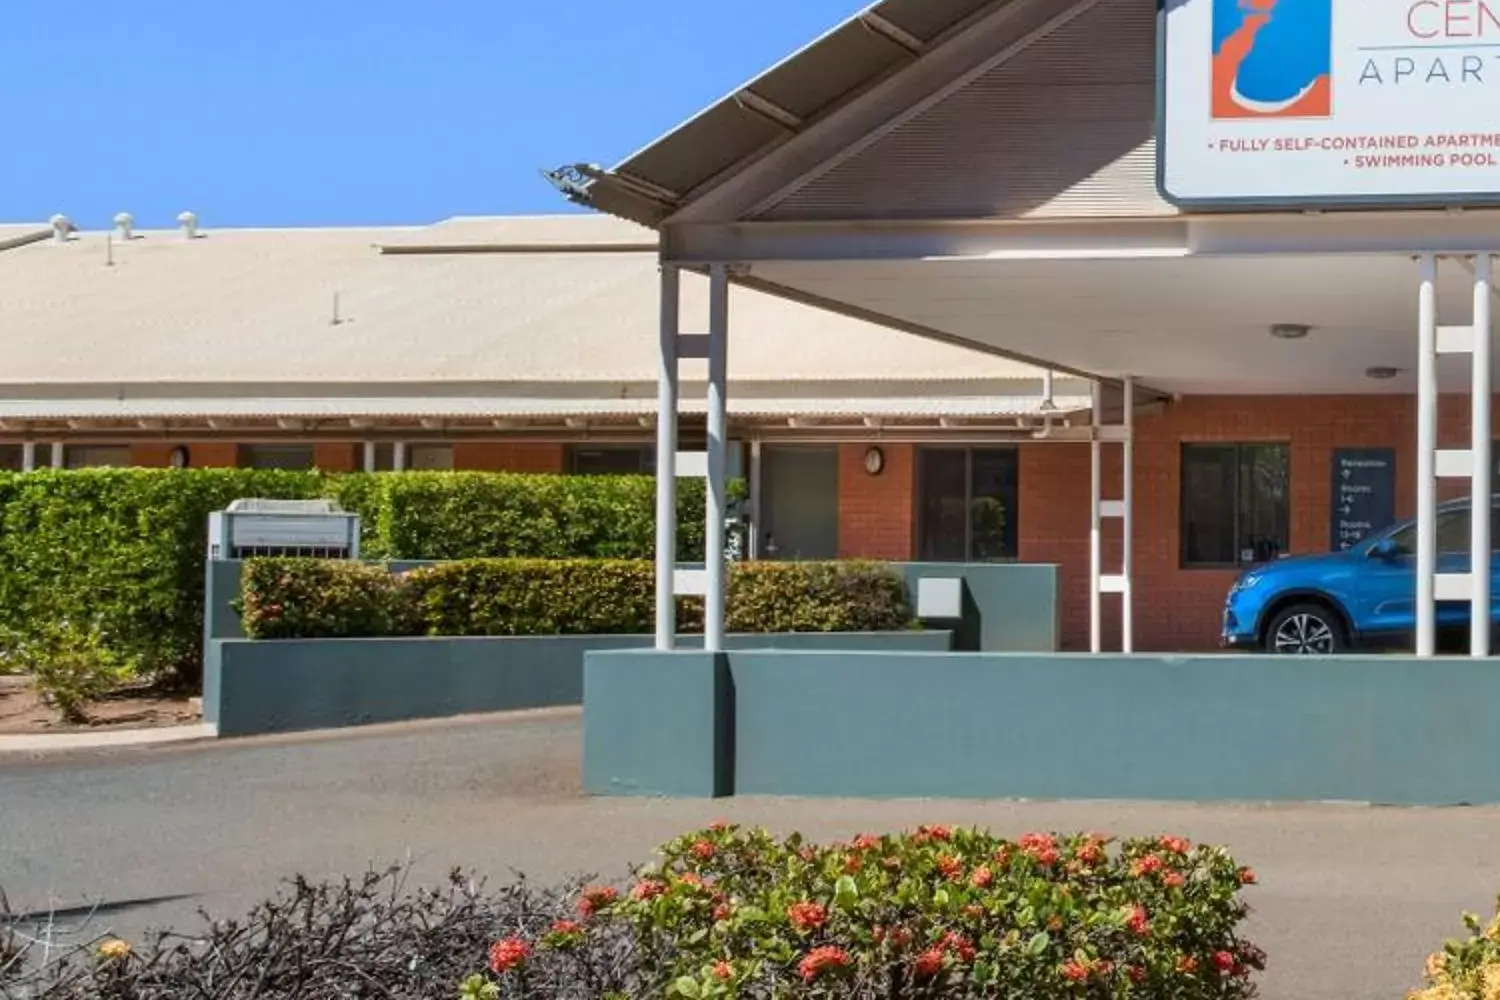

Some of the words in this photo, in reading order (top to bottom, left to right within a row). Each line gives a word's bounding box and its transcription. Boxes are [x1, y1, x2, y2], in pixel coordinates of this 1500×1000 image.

[1219, 138, 1268, 152] FULLY
[1274, 135, 1419, 150] SELF-CONTAINED
[1355, 153, 1446, 168] SWIMMING
[1450, 152, 1497, 166] POOL
